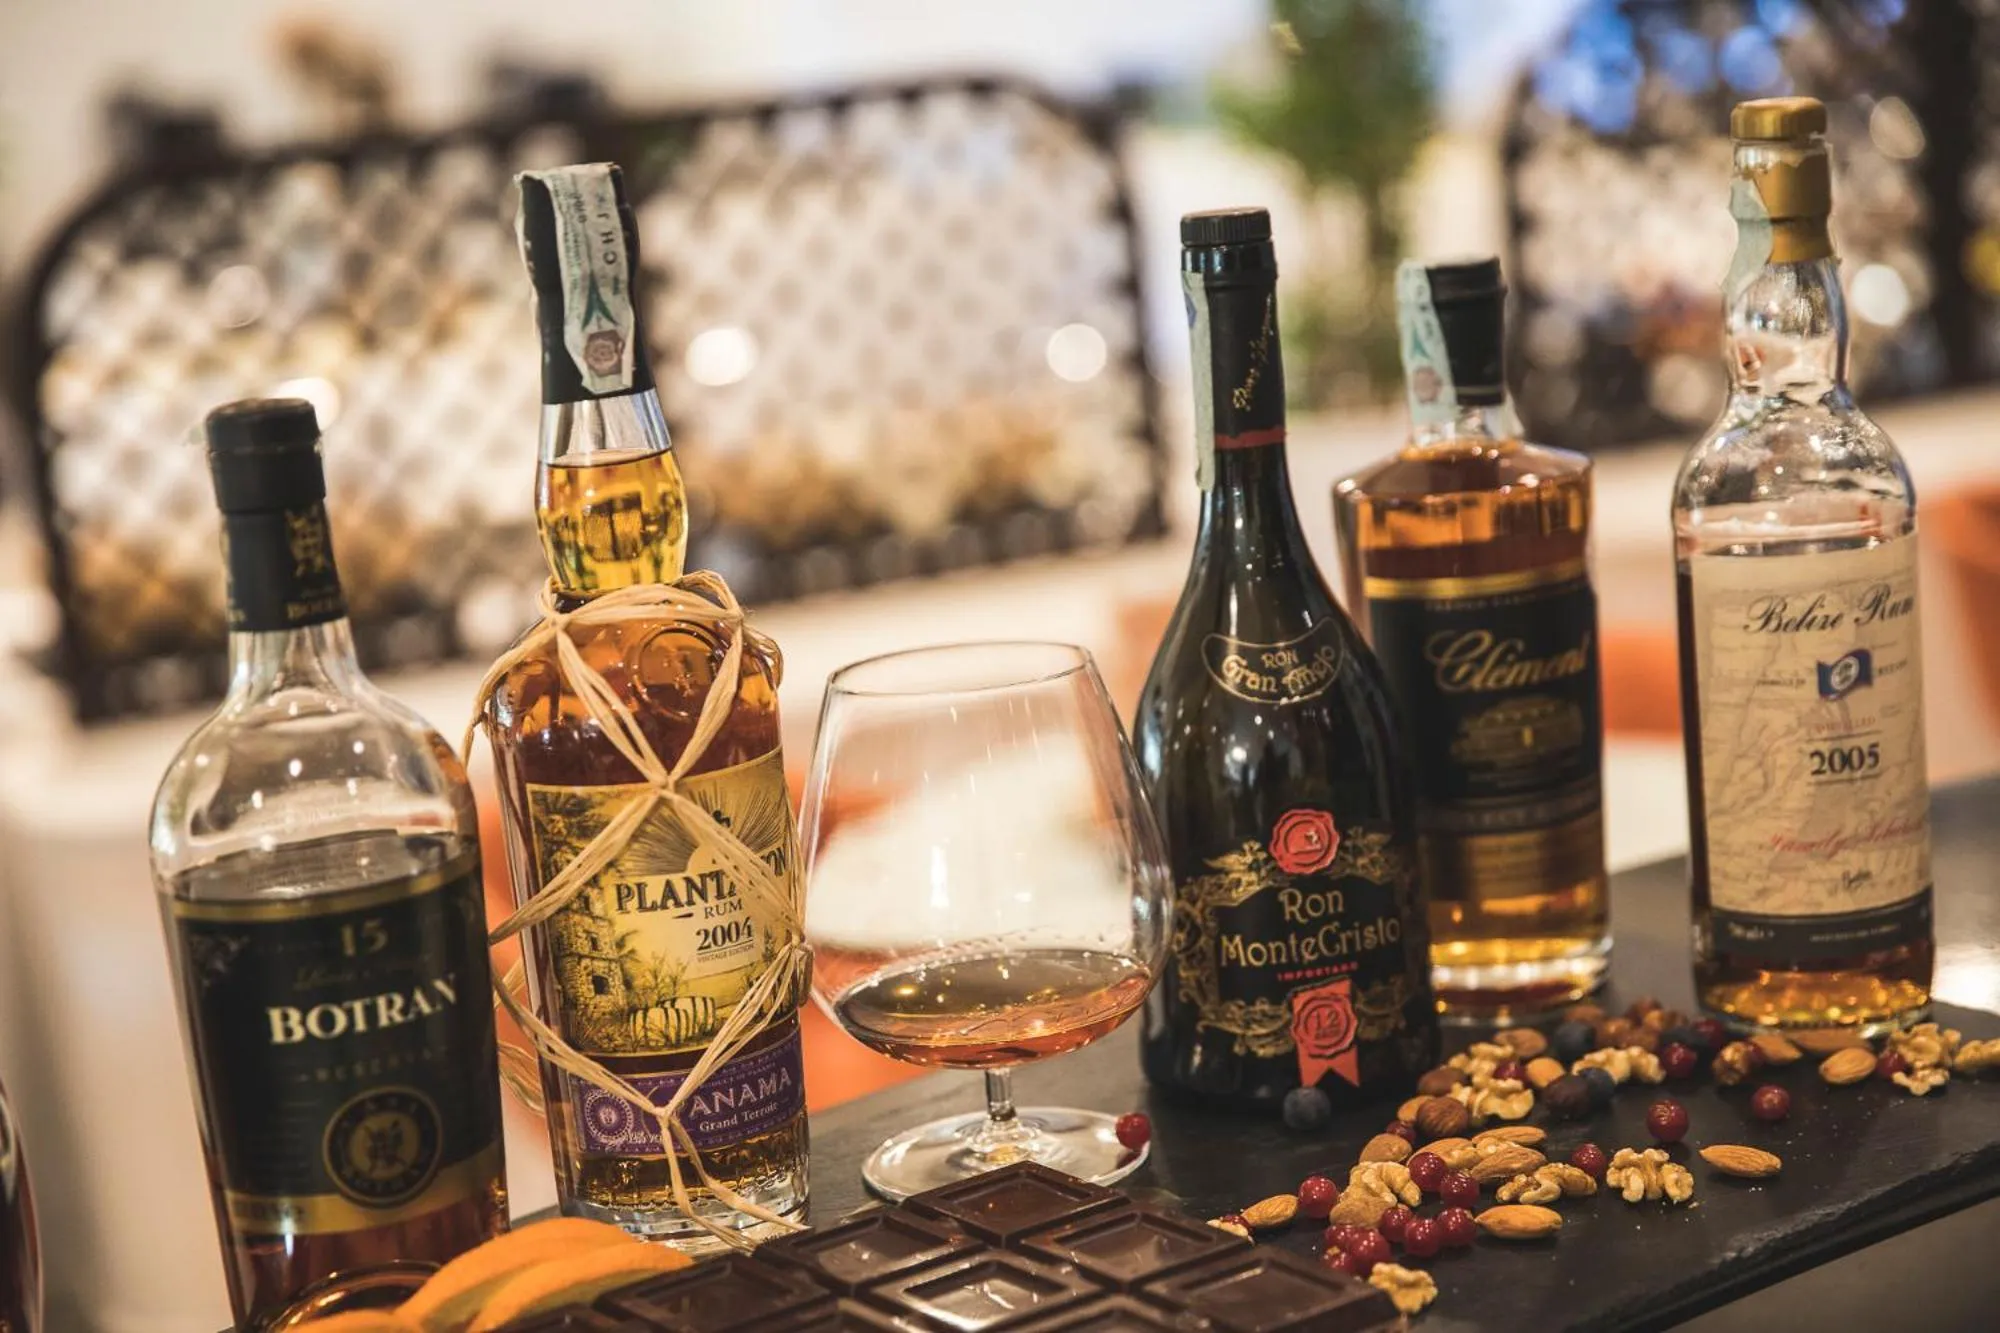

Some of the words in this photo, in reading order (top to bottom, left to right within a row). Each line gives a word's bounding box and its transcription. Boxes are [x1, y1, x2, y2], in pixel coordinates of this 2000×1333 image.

[1742, 593, 1845, 634] Belize
[1809, 742, 1881, 777] 2005
[704, 898, 743, 919] RUM
[1278, 887, 1345, 924] Ron
[340, 918, 388, 958] 15
[696, 916, 752, 950] 2004
[1219, 916, 1401, 967] MonteCristo
[267, 973, 458, 1045] BOTRAN
[1314, 1008, 1341, 1030] 12
[675, 1066, 792, 1119] ANAMA
[699, 1113, 738, 1132] Grand
